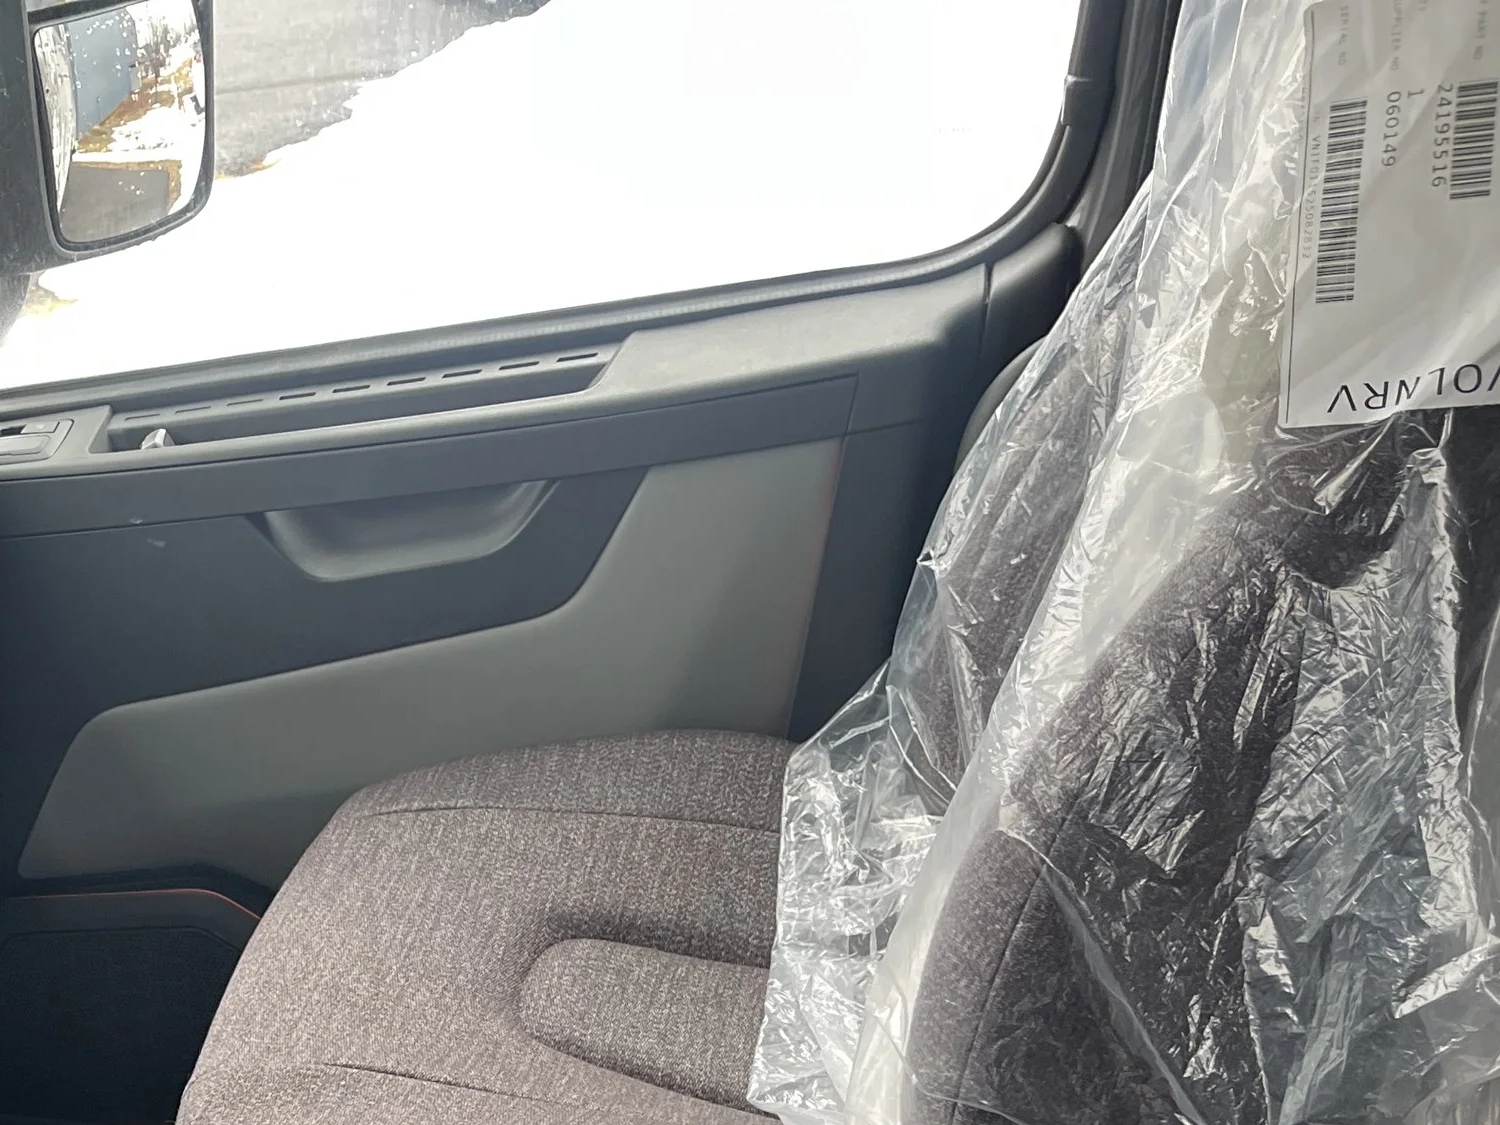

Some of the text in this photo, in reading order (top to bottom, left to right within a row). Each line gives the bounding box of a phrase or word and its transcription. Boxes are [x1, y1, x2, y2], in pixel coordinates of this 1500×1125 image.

[1381, 91, 1402, 168] 060149
[1407, 88, 1425, 99] 1
[1431, 83, 1454, 188] 24195516
